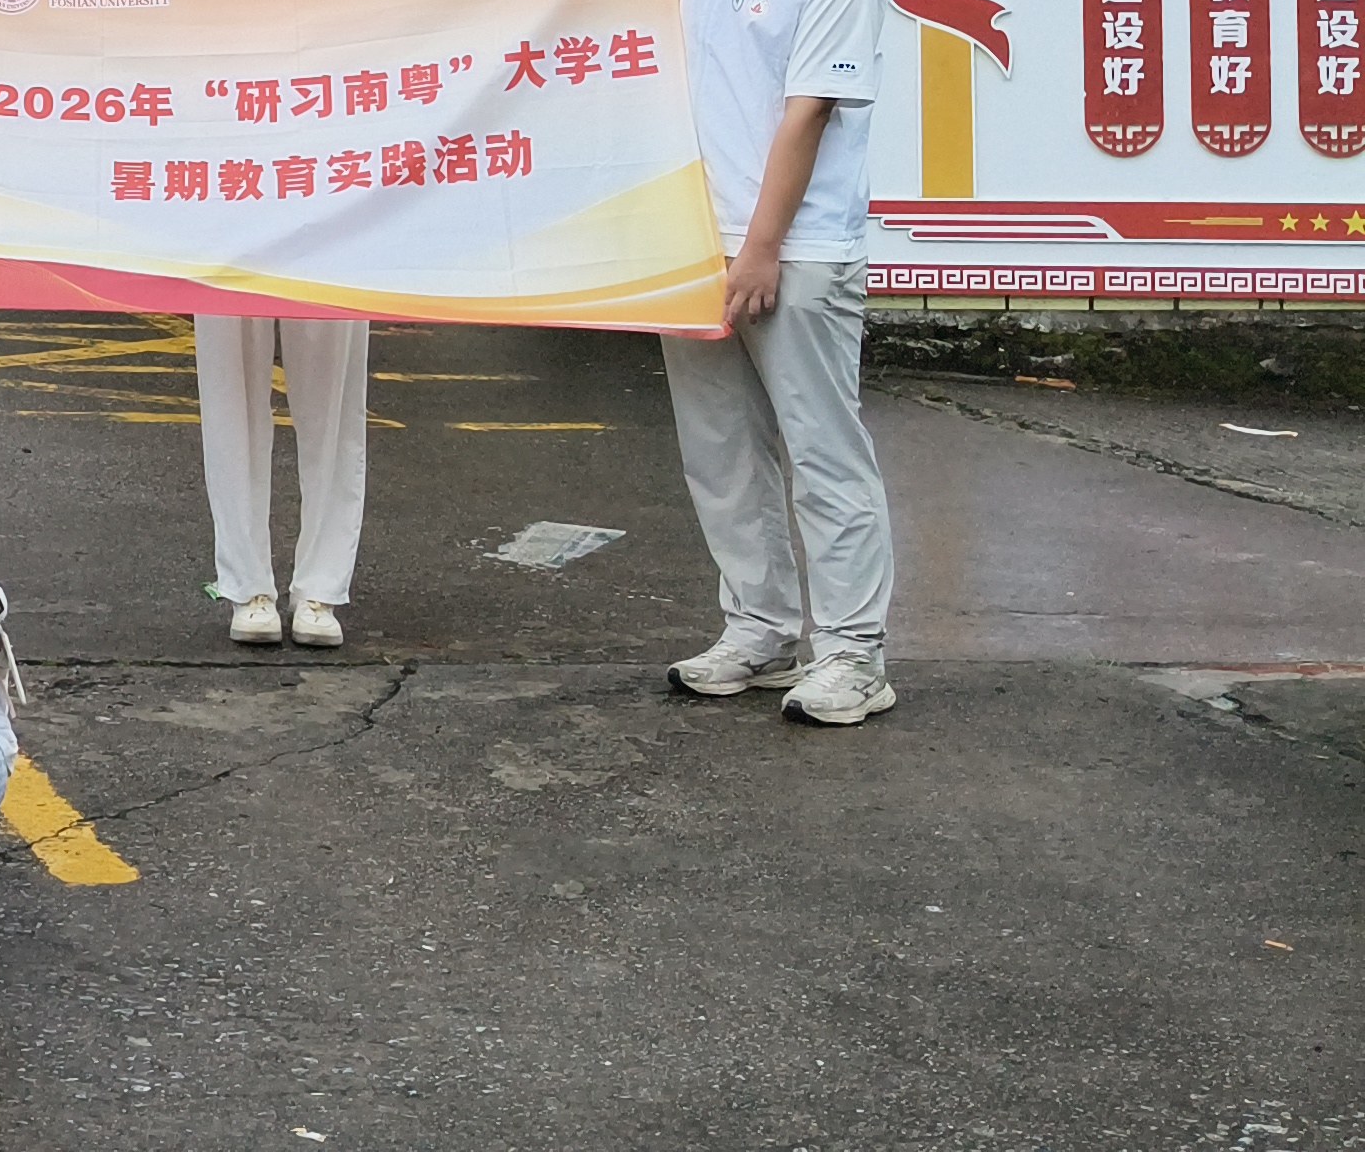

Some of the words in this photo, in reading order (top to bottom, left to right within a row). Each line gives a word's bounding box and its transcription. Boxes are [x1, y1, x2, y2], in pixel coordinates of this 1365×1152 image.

[503, 29, 661, 92] 大学生
[110, 129, 534, 202] 暑期教育实践活动
